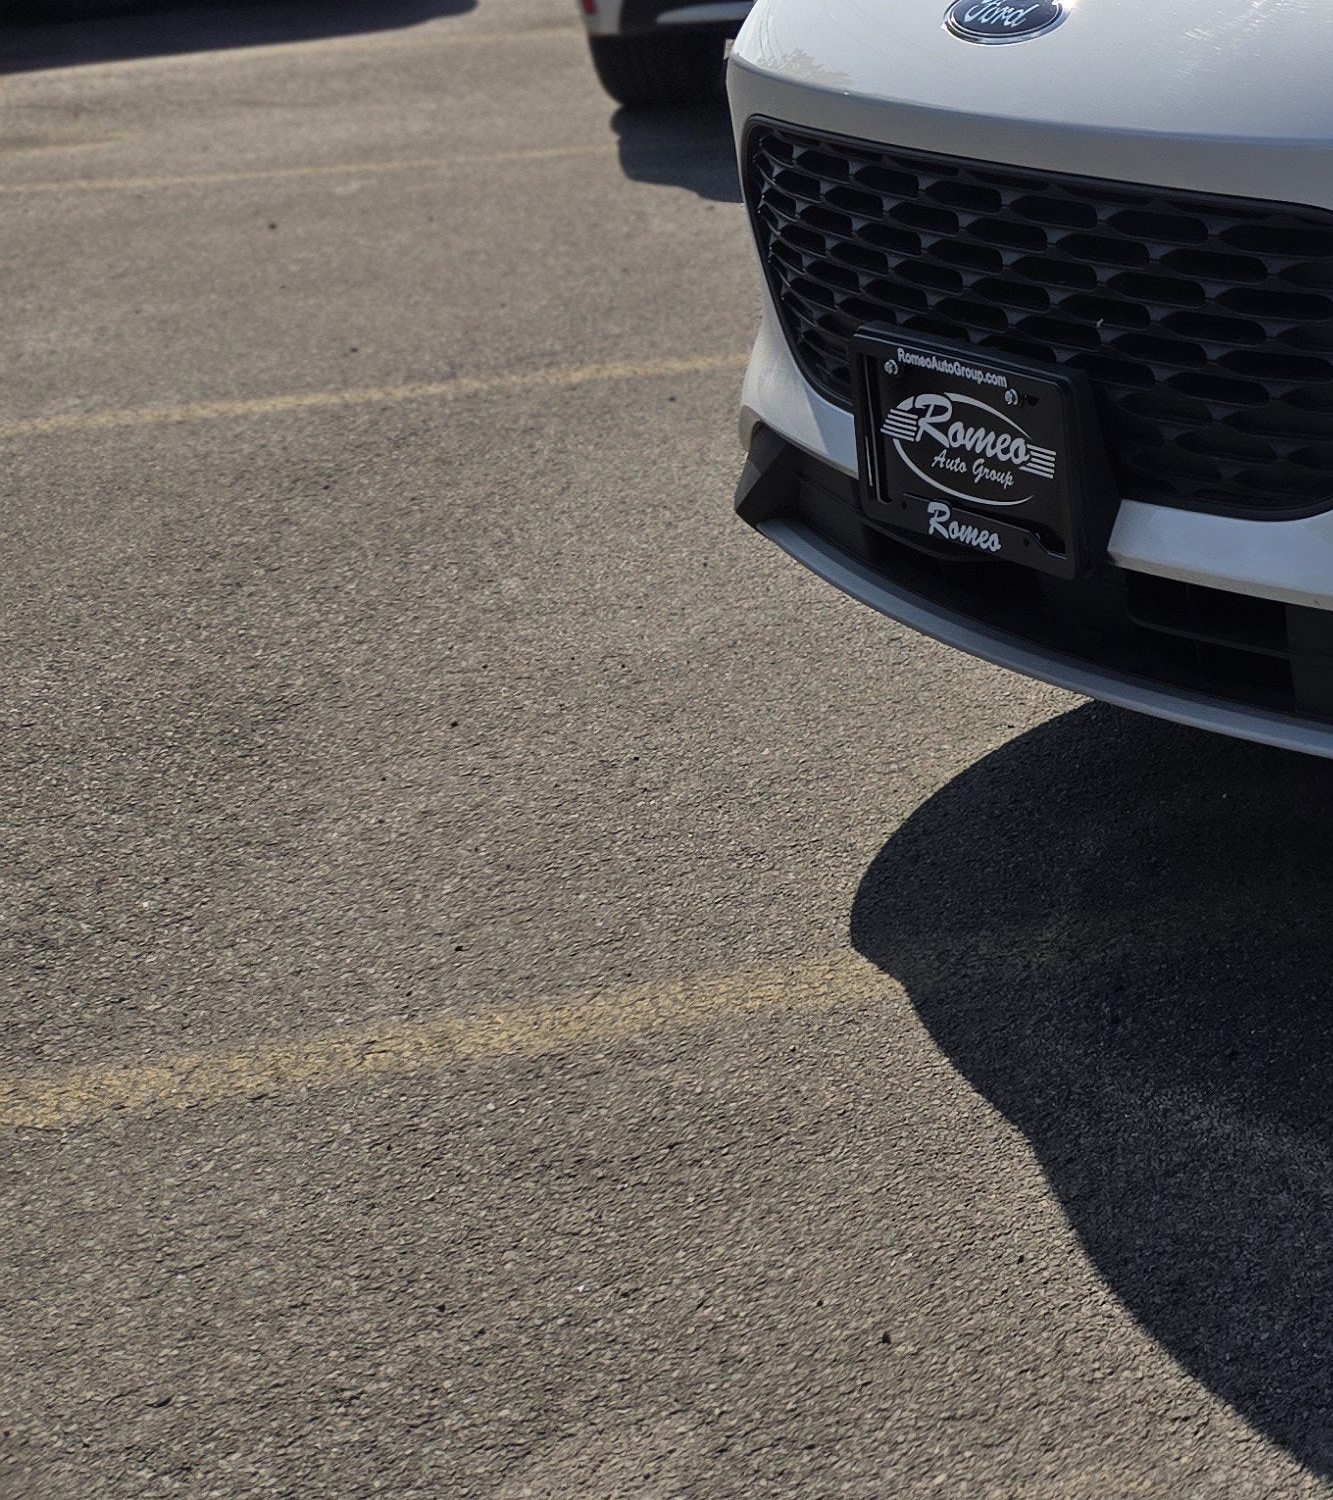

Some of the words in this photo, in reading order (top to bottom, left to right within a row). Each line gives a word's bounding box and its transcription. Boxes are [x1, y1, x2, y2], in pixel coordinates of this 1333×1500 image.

[896, 347, 1008, 389] RomeoAutoGroup.com
[914, 393, 1031, 465] Romeo
[931, 448, 968, 474] Auto
[972, 458, 1015, 489] Group
[926, 502, 1002, 552] Romeo
